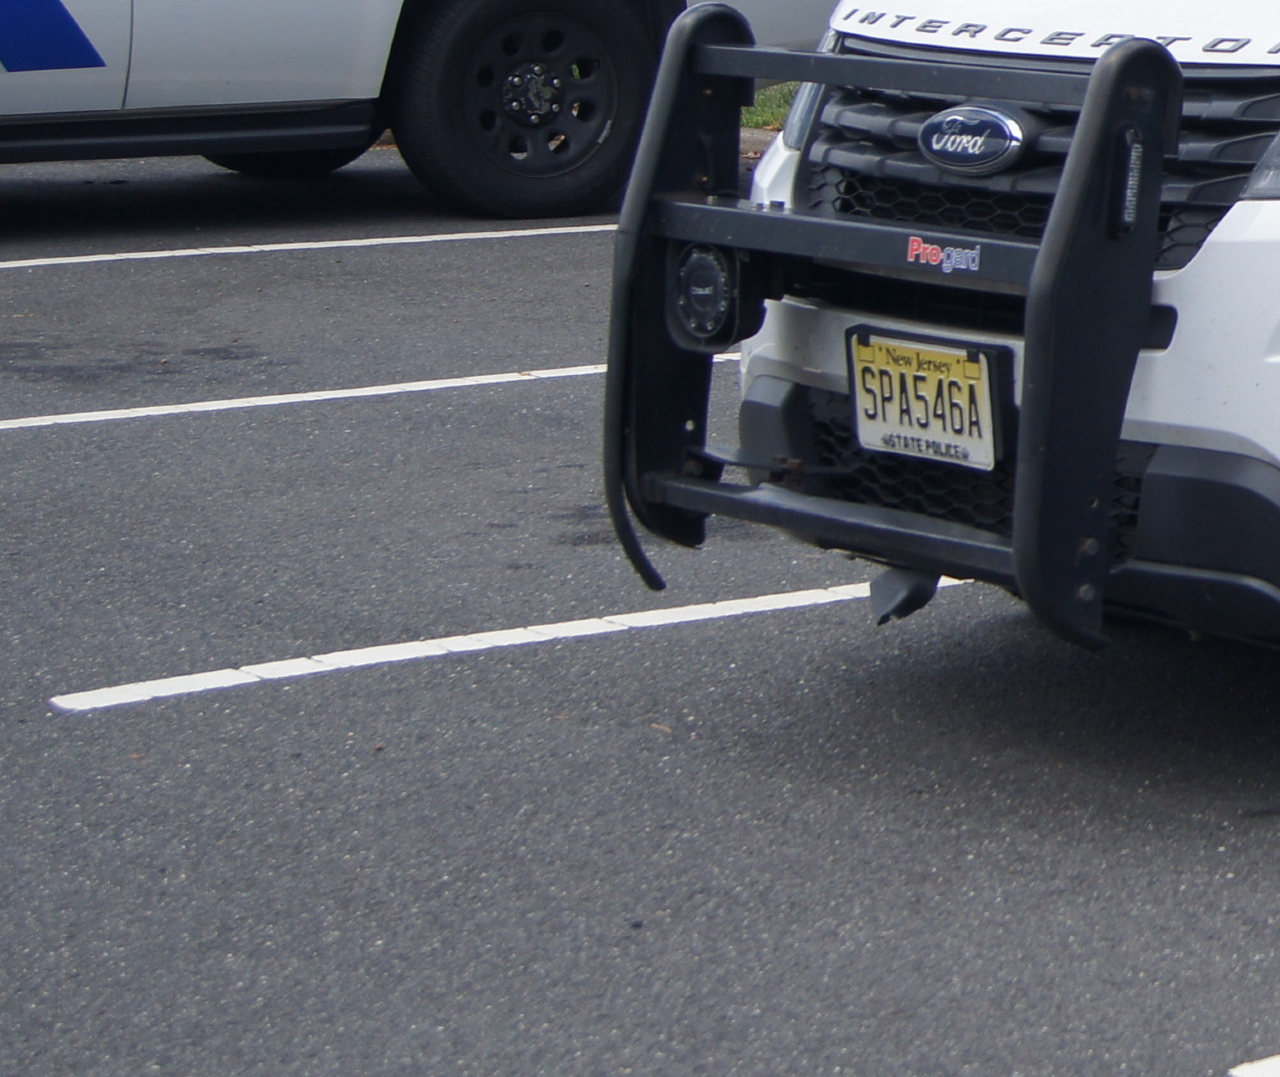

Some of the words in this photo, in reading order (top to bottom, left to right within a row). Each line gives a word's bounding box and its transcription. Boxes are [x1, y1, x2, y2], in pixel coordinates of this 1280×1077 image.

[931, 115, 991, 155] Ford
[907, 236, 980, 273] Pro-gard
[885, 347, 913, 367] New
[915, 352, 953, 376] Jersey
[861, 366, 983, 439] SPA546A
[889, 433, 924, 453] STATE
[925, 439, 962, 458] POLICE
